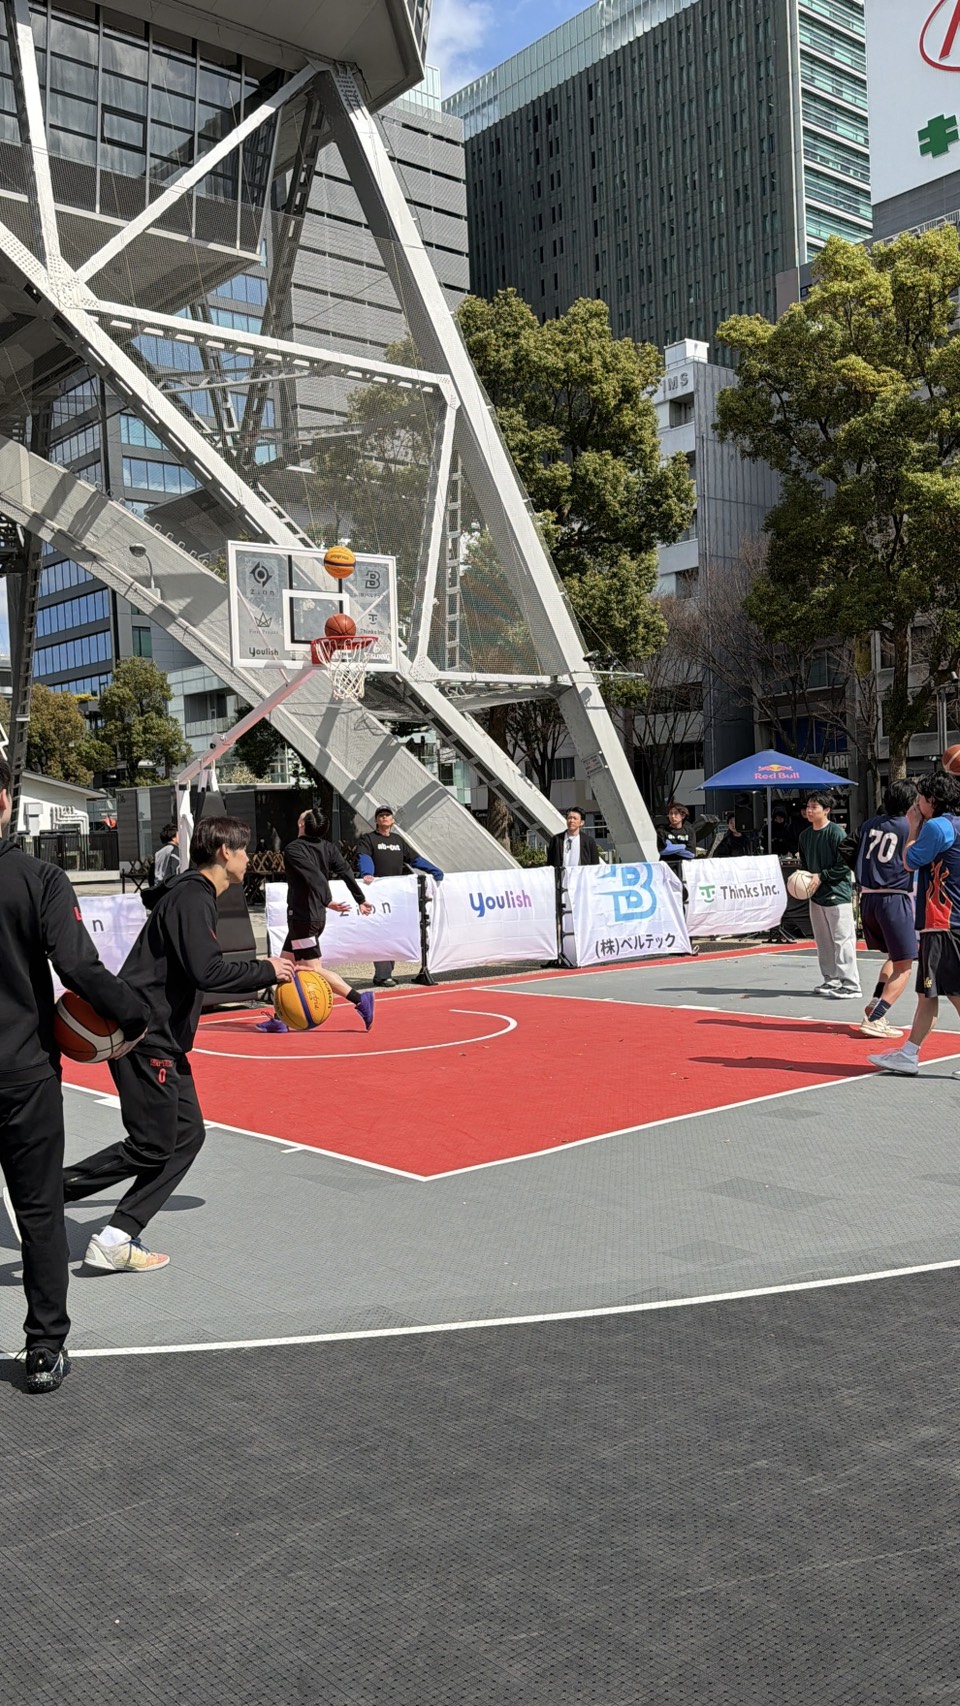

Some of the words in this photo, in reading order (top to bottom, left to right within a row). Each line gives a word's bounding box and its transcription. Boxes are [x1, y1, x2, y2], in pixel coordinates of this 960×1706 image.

[778, 771, 800, 779] Bull
[865, 828, 899, 863] 70
[720, 884, 760, 900] Thinks
[760, 883, 780, 897] Inc.
[595, 932, 676, 958] (株)ベルテック
